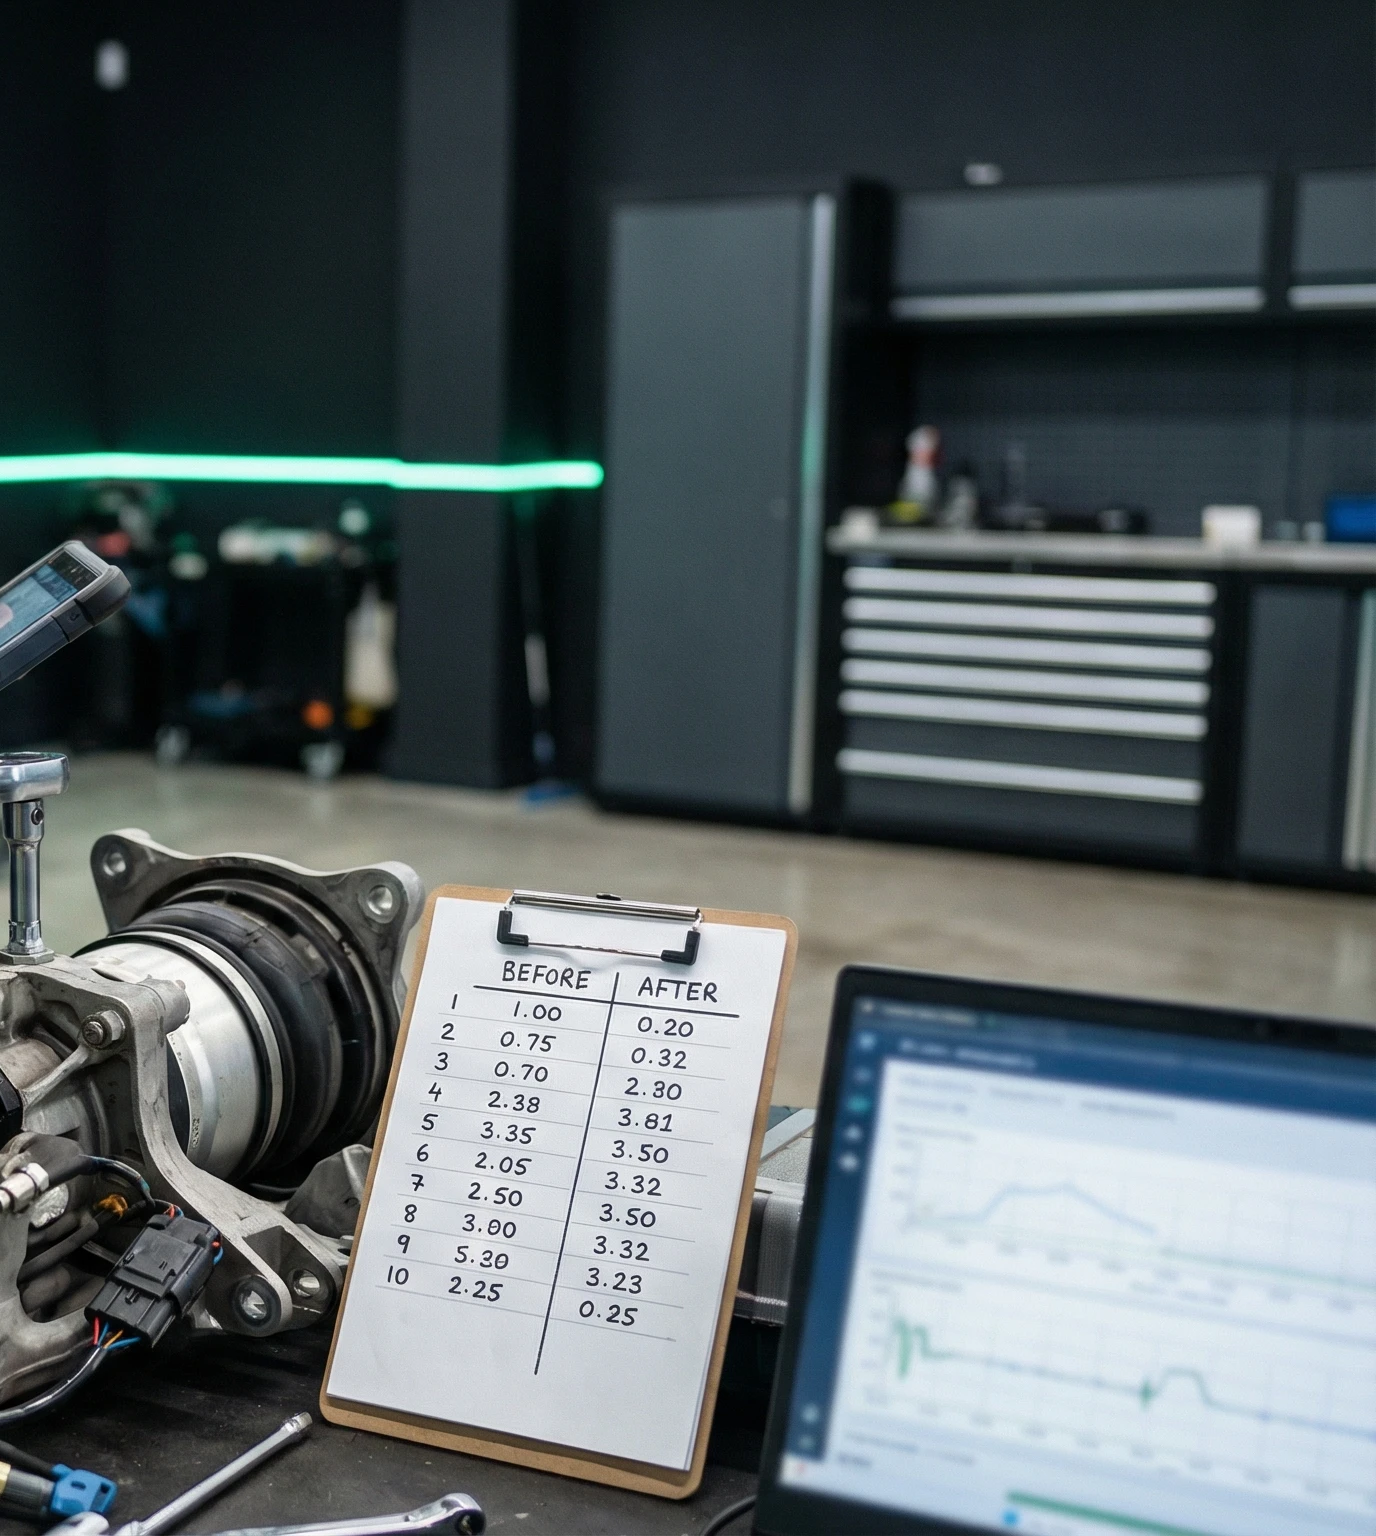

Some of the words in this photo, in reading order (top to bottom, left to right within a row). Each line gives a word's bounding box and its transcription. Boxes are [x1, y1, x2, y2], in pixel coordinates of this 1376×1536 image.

[502, 960, 592, 990] BEFORE
[637, 976, 718, 1003] AFTER
[451, 993, 458, 1010] 1
[513, 1001, 562, 1022] 1.00
[637, 1016, 694, 1038] 0.20
[441, 1022, 455, 1041] 2
[500, 1031, 557, 1052] 0.75
[631, 1047, 687, 1070] 0.32
[434, 1051, 449, 1071] 3
[494, 1061, 548, 1083] 0.70
[624, 1077, 682, 1101] 2.30
[428, 1082, 442, 1102] 4
[487, 1090, 540, 1114] 2.38
[618, 1108, 672, 1132] 3.81
[421, 1113, 439, 1131] 5
[480, 1121, 537, 1145] 3.35
[611, 1139, 669, 1164] 3.50
[416, 1143, 429, 1162] 6
[474, 1151, 533, 1176] 2.05
[604, 1171, 662, 1197] 3.32
[411, 1173, 425, 1192] 7
[467, 1182, 523, 1207] 2.50
[599, 1203, 656, 1228] 3.50
[404, 1203, 418, 1223] 8
[593, 1235, 650, 1262] 3.32
[397, 1234, 411, 1254] 9
[585, 1267, 642, 1295] 3.23
[387, 1265, 409, 1285] 10
[448, 1276, 504, 1302] 2.25
[579, 1300, 638, 1327] 0.25
